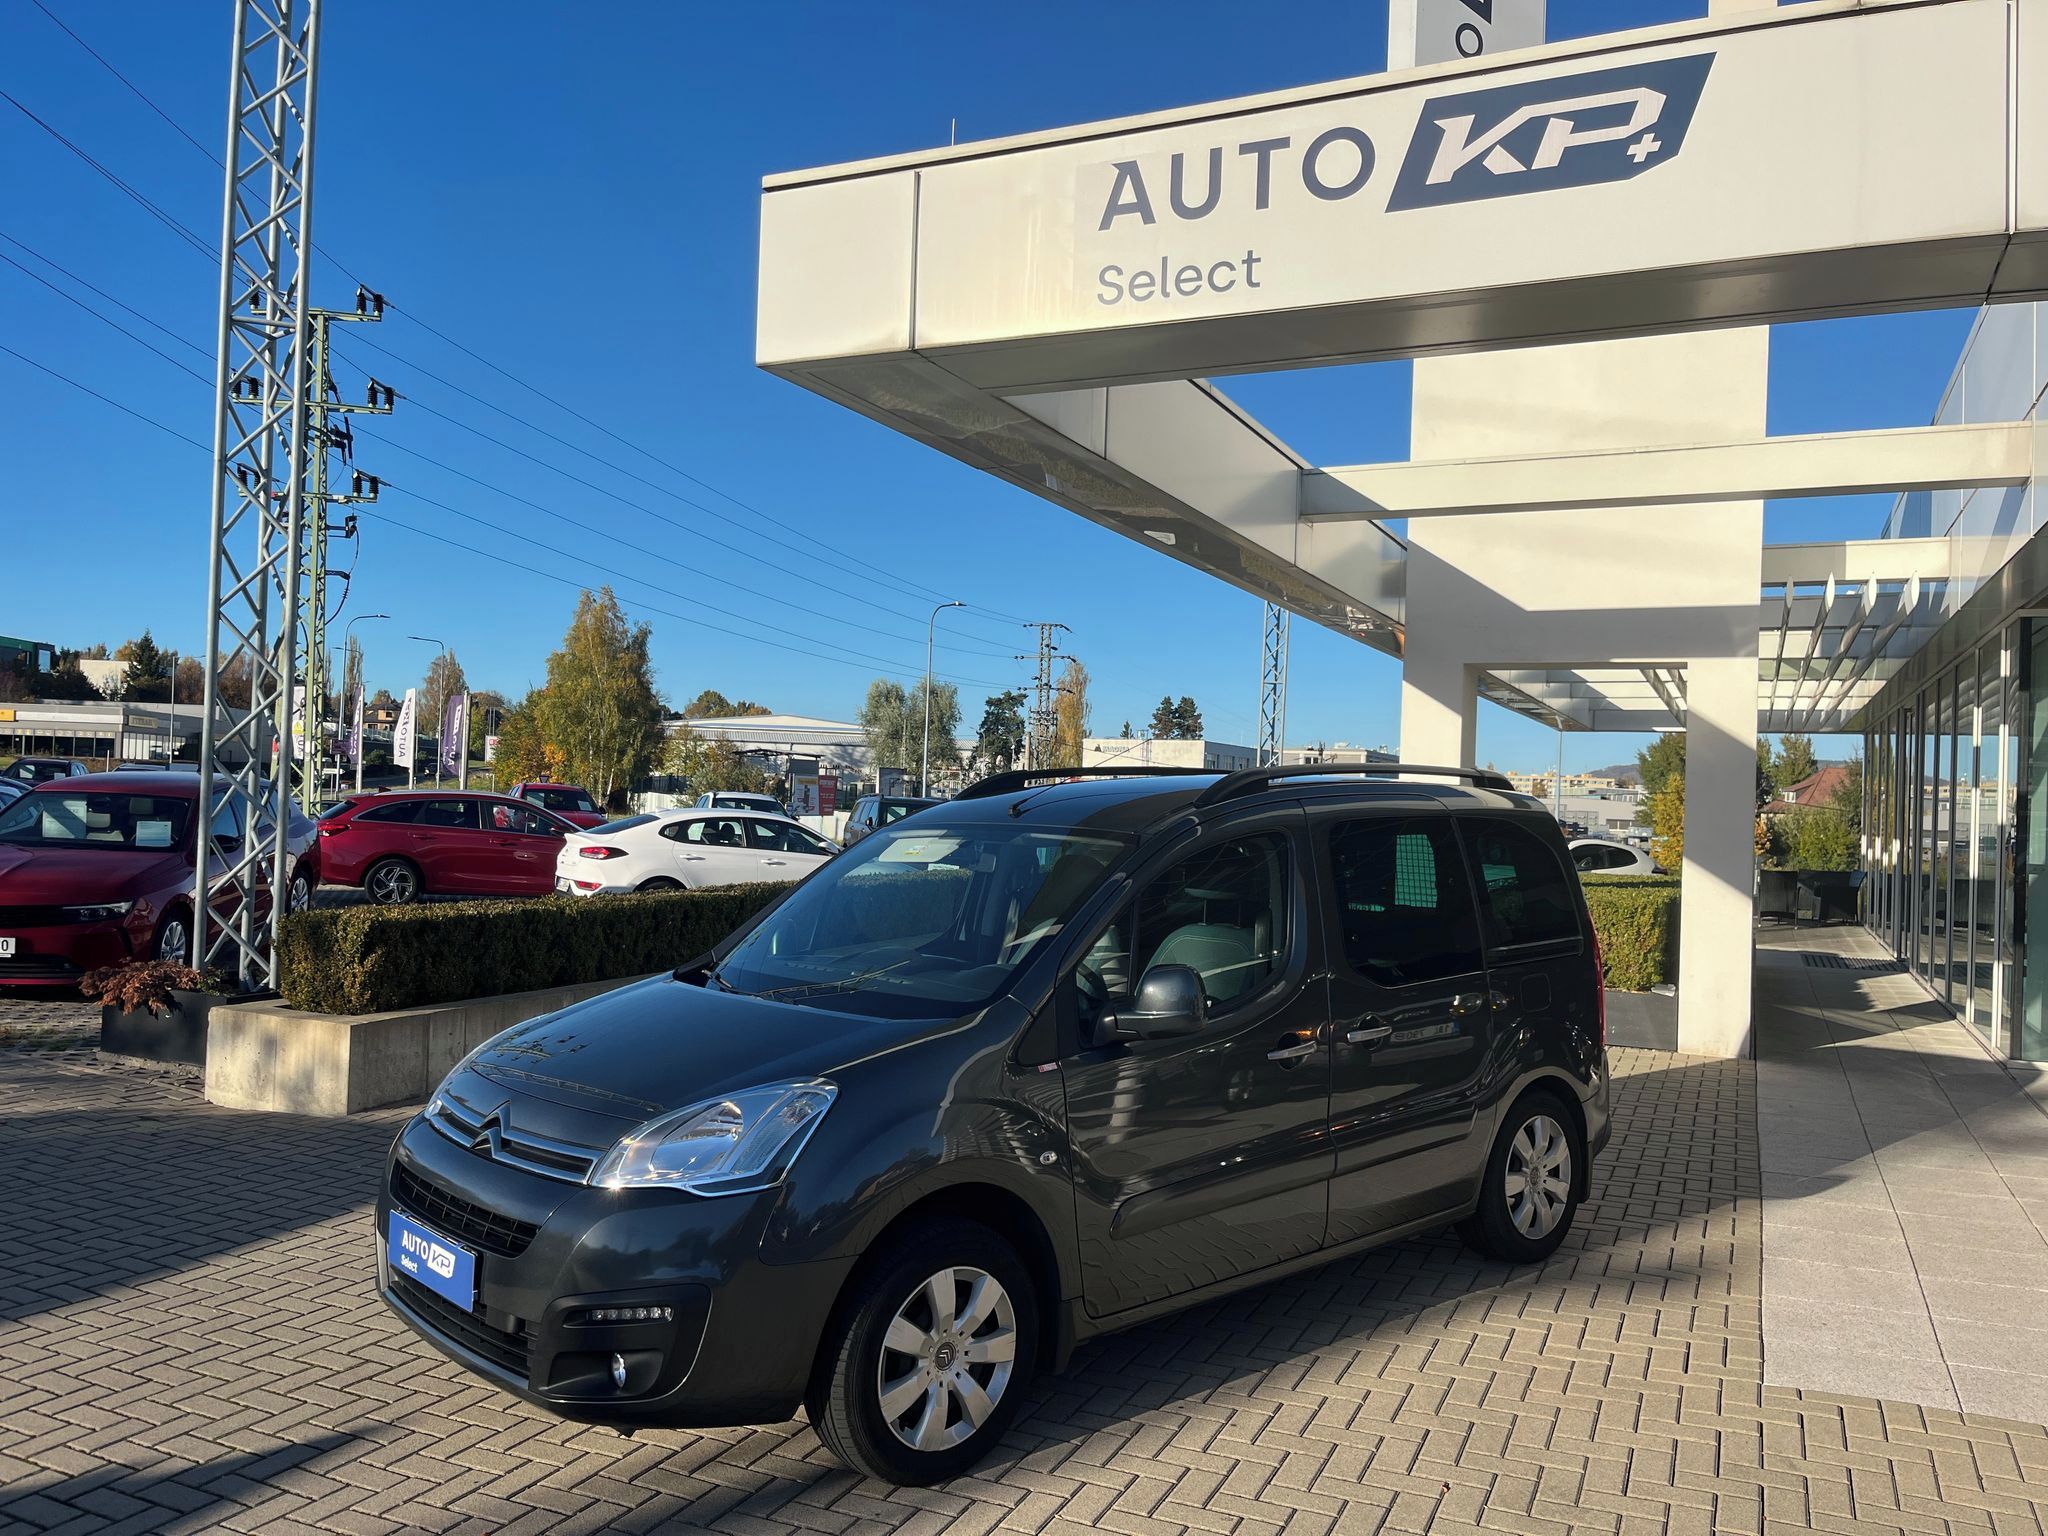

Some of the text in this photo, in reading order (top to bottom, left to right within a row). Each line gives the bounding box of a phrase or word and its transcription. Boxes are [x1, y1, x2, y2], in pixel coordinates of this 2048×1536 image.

[1098, 126, 1376, 231] AUTO
[1097, 249, 1262, 306] Select
[401, 1254, 418, 1273] Select
[402, 1230, 429, 1260] AUTO
